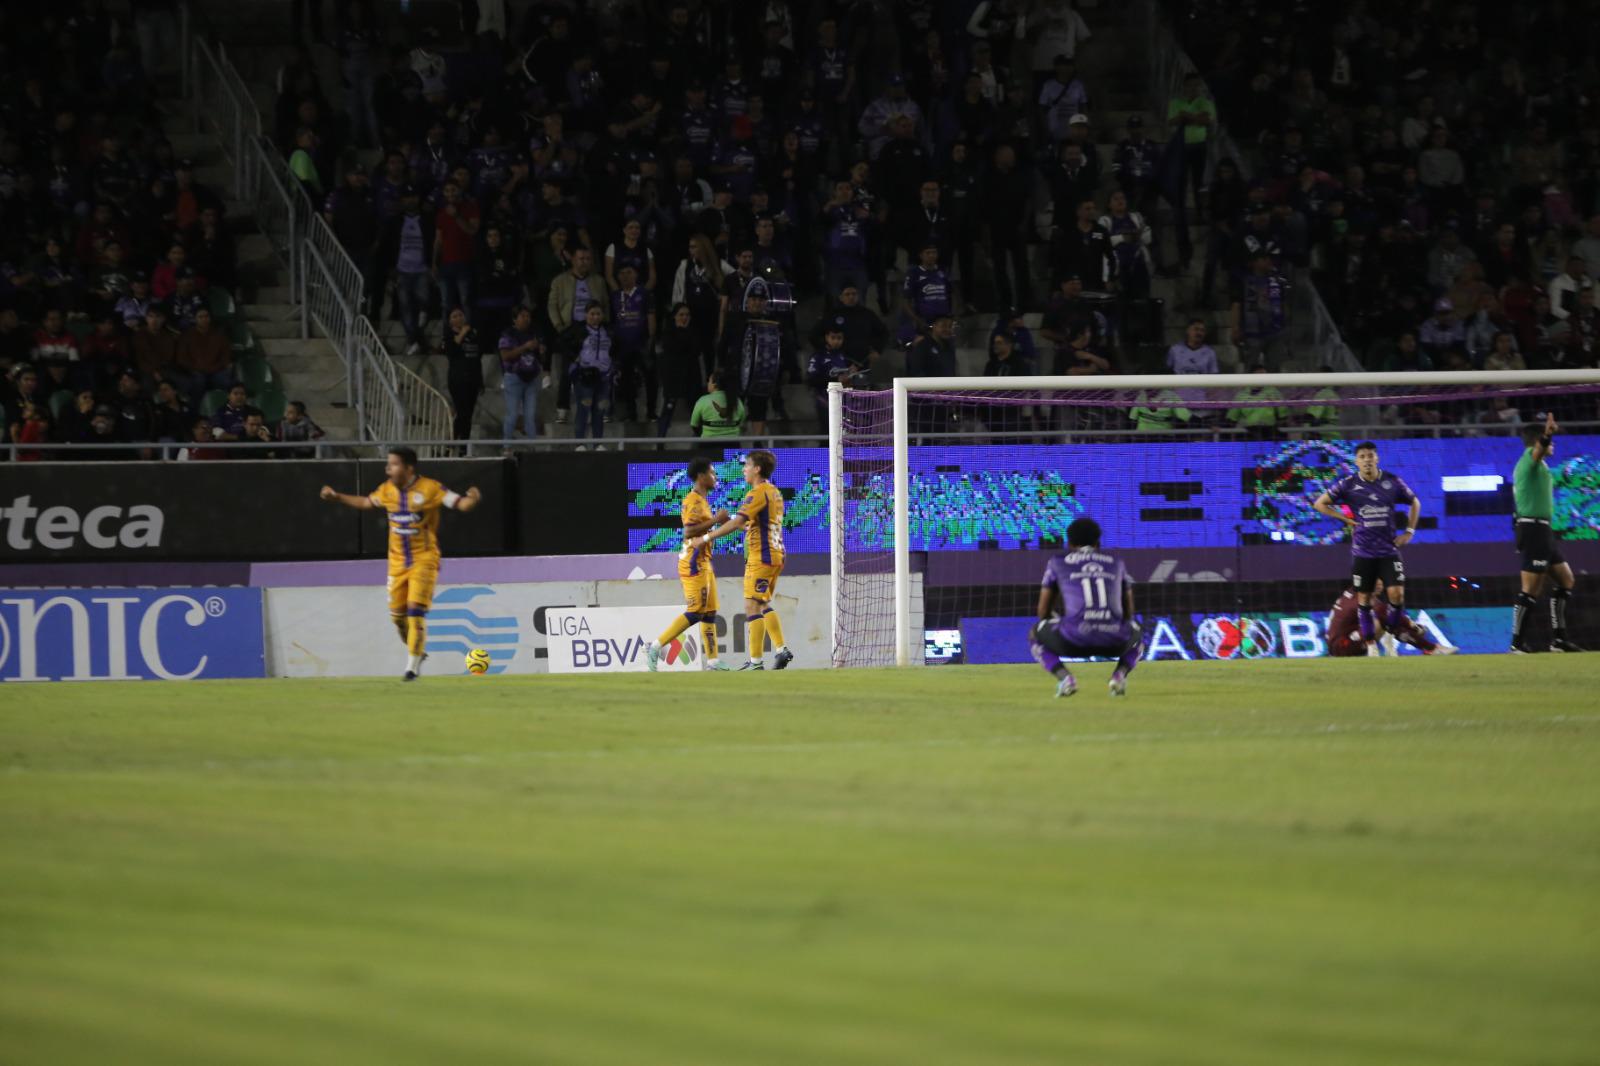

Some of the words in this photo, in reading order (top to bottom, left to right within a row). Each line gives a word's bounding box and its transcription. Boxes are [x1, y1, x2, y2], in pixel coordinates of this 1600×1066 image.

[0, 494, 165, 550] teca
[1081, 577, 1108, 608] 11
[549, 616, 592, 636] LIGA
